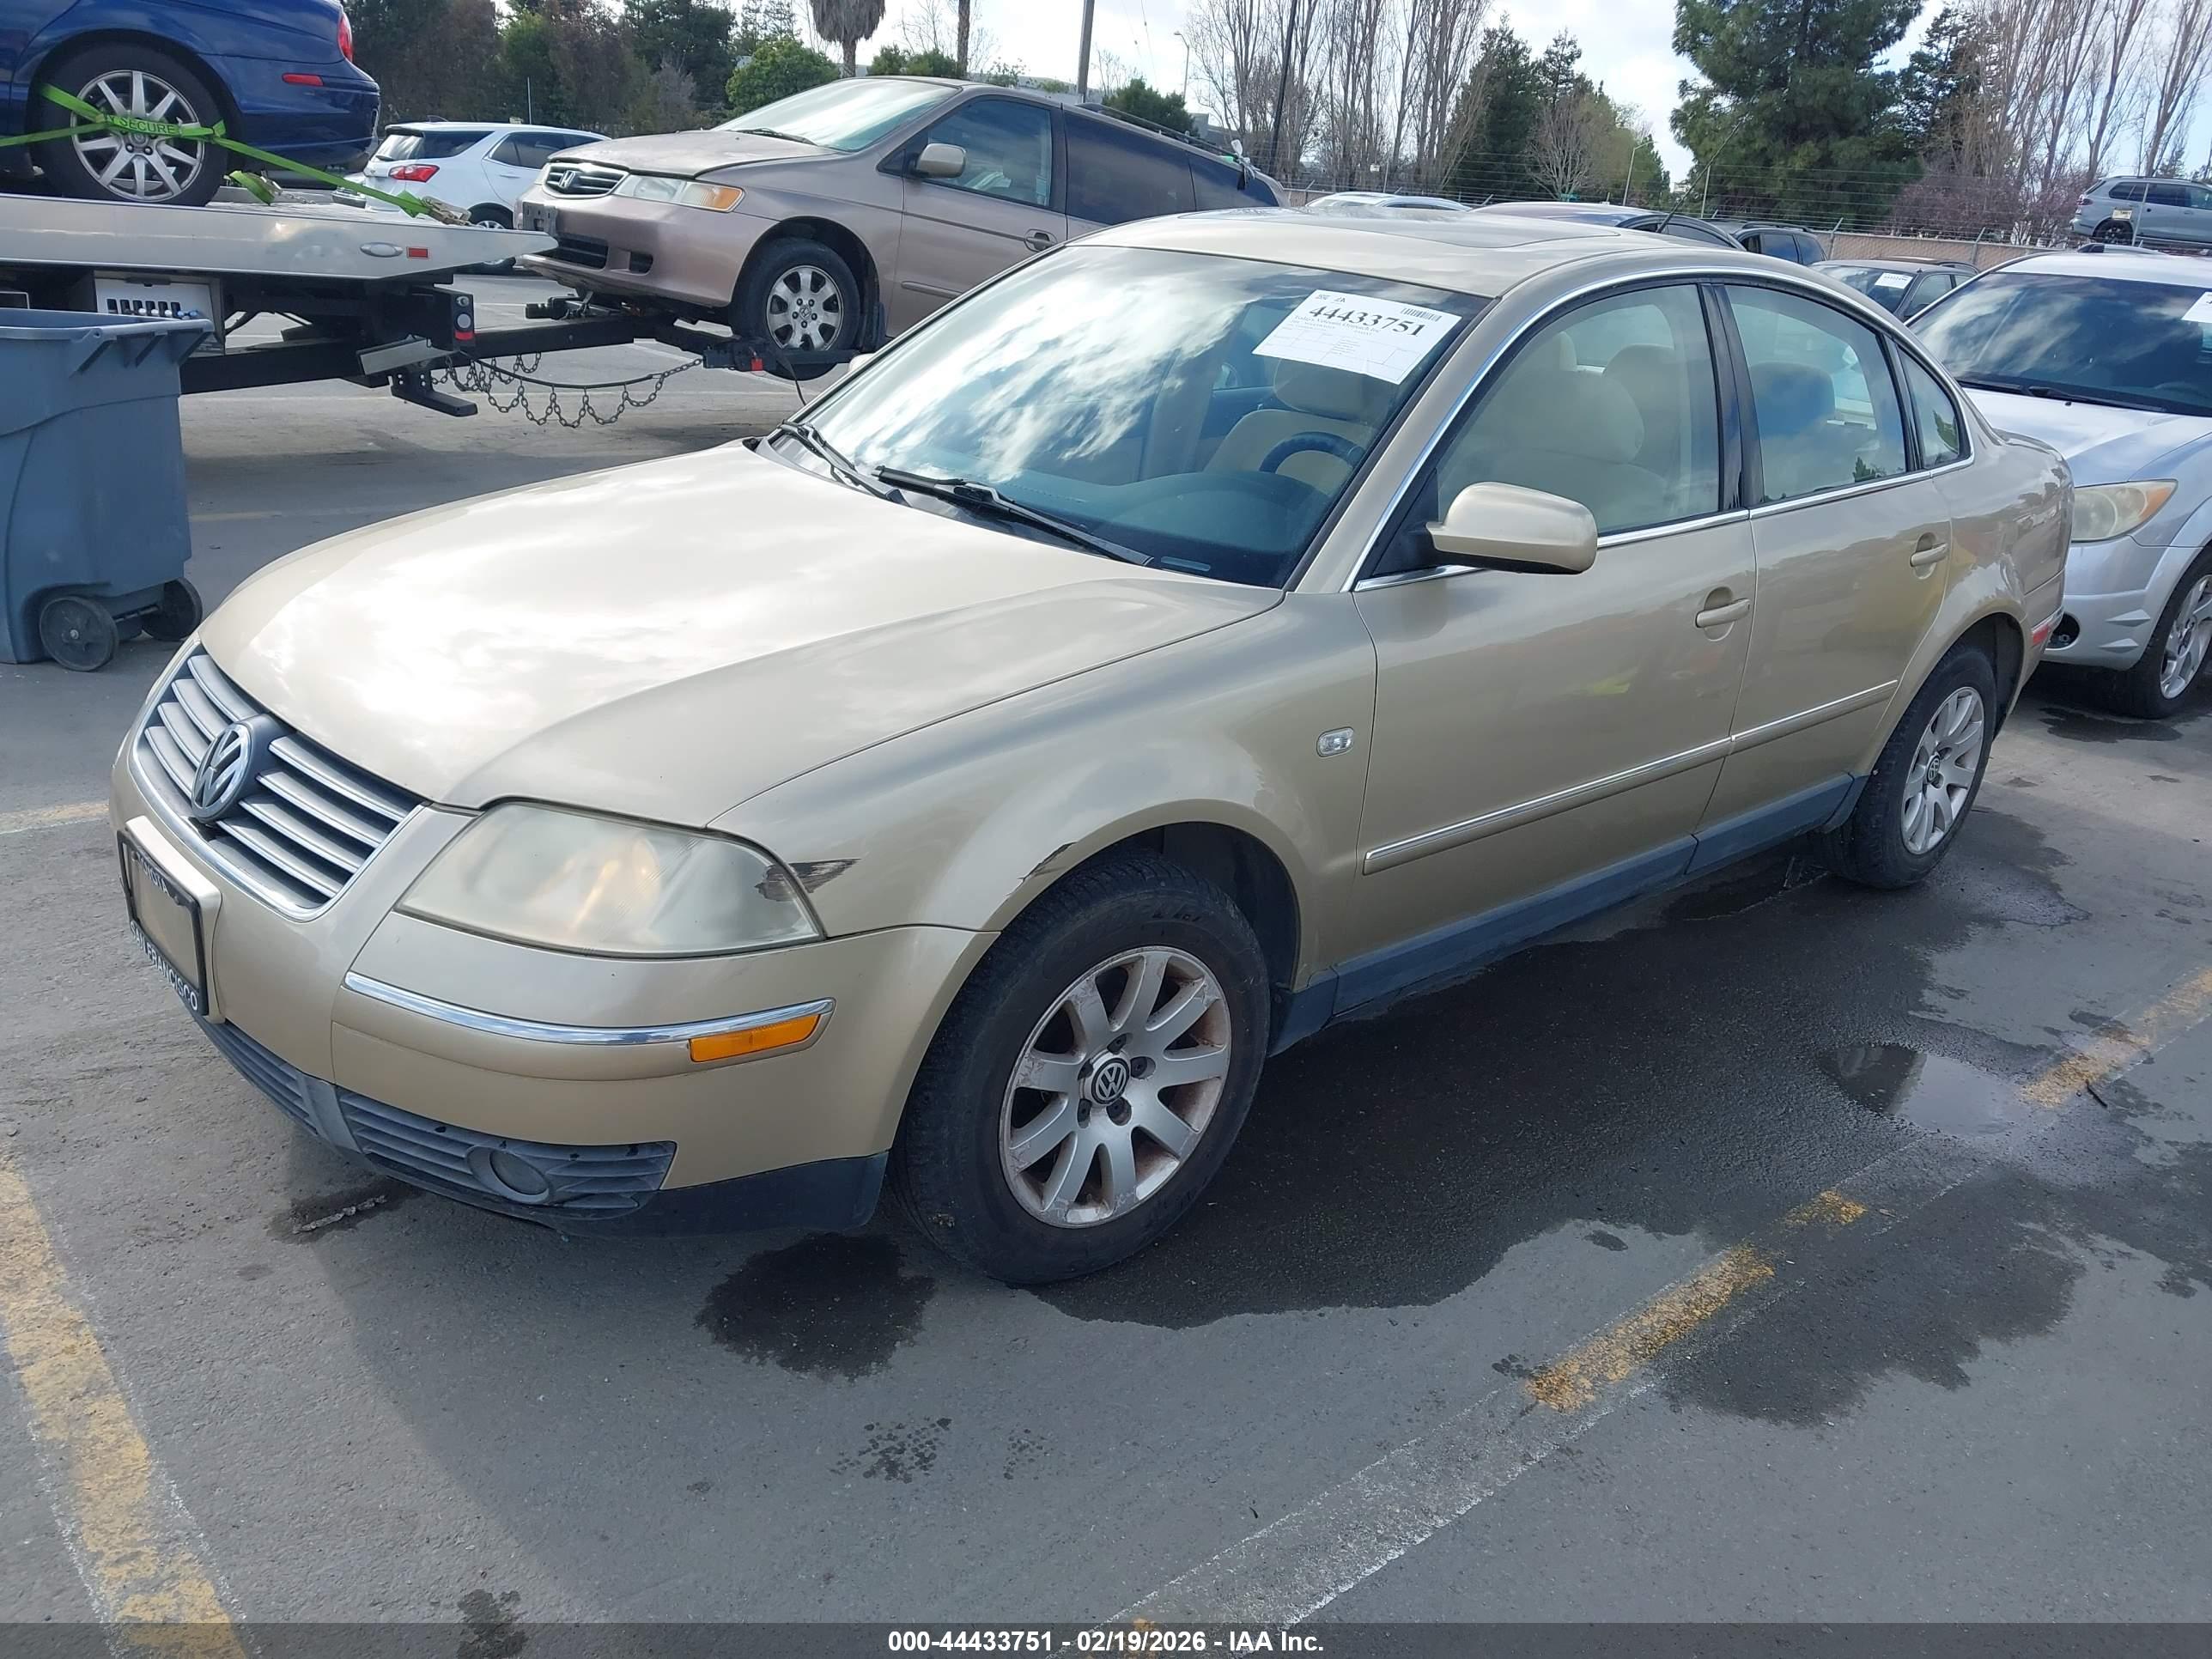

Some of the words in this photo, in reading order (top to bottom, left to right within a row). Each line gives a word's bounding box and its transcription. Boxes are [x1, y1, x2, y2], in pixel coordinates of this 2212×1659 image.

[119, 117, 175, 134] SECURE
[1309, 305, 1426, 337] 44433751
[137, 851, 170, 896] TOYOTA
[131, 920, 148, 954] SAN
[146, 941, 198, 1012] FRANCISCO
